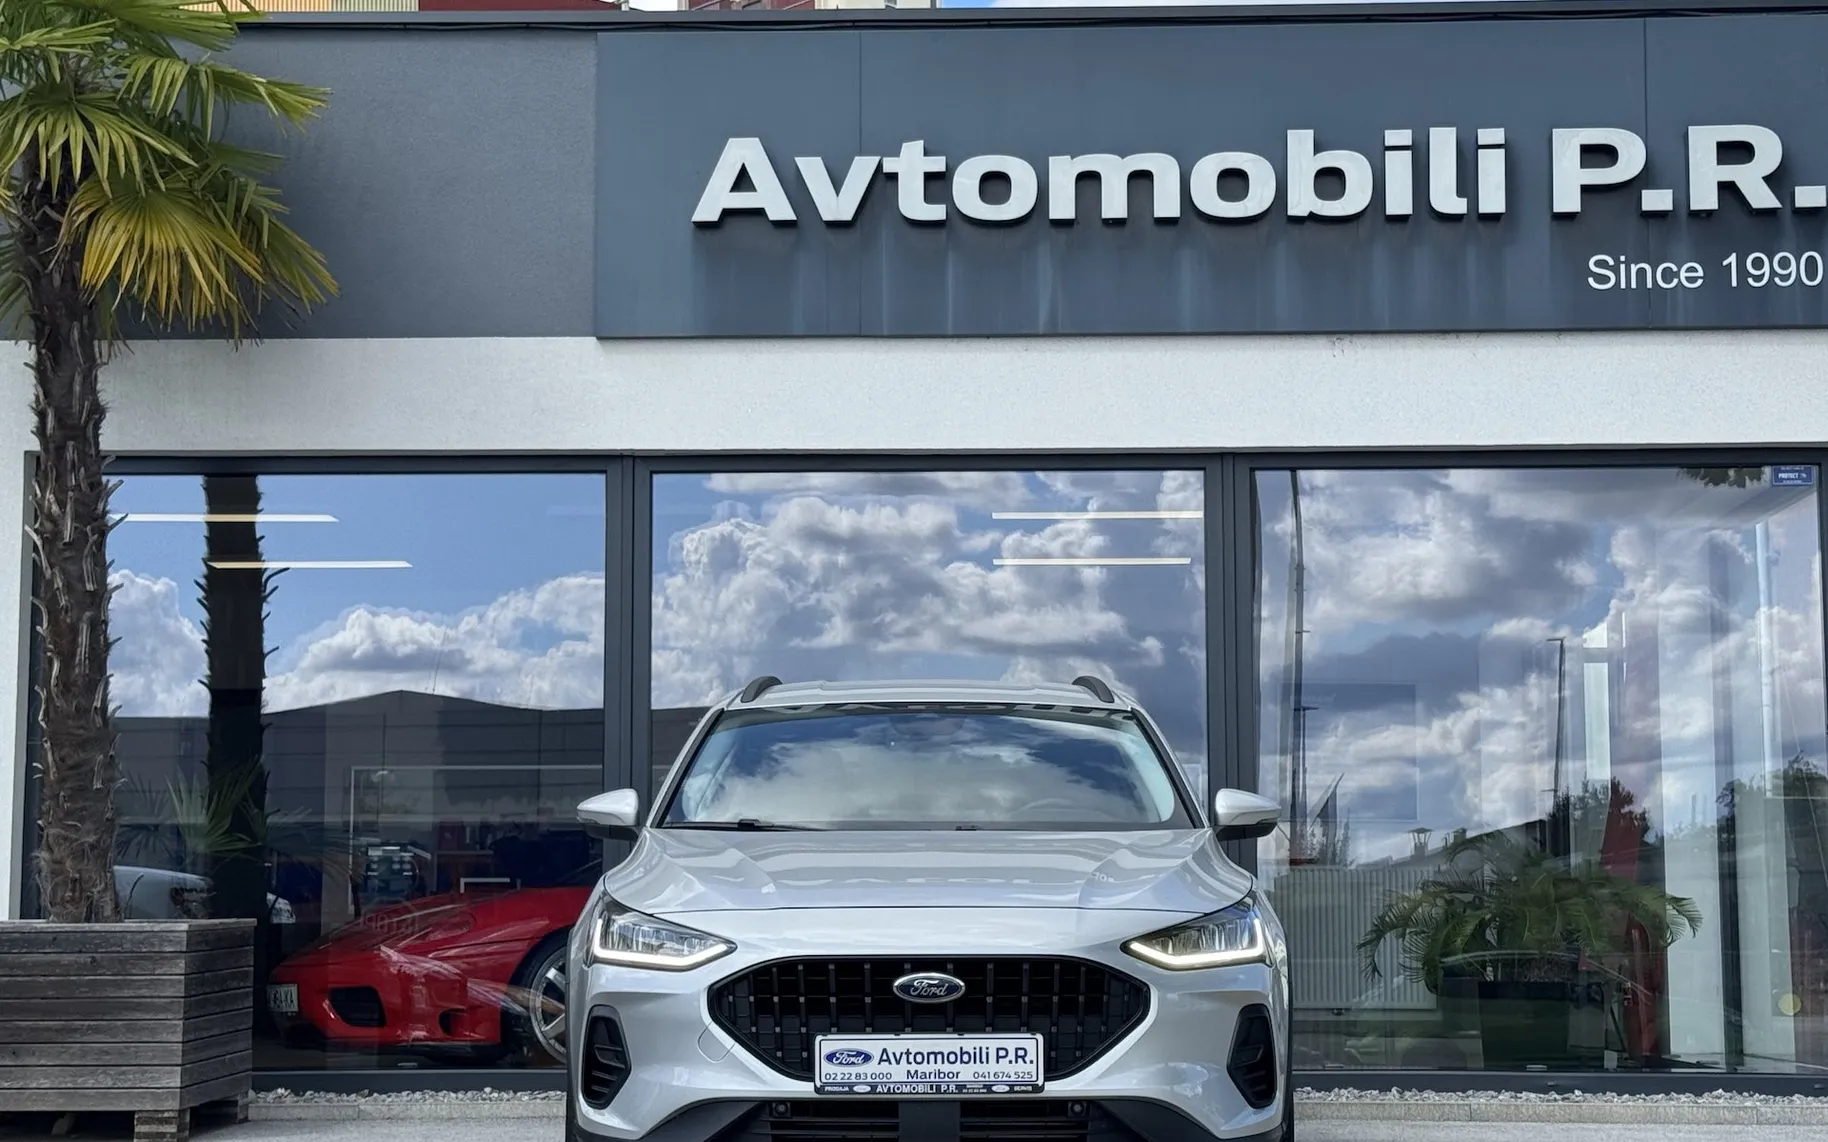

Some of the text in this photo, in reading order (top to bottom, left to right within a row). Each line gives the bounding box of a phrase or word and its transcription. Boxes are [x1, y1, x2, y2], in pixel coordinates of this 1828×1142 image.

[691, 124, 1827, 223] Avtomobili P.R.
[1587, 251, 1824, 290] Since 1990
[910, 979, 949, 996] Ford
[832, 1051, 866, 1064] Ford
[877, 1046, 1034, 1066] Avtomobili P.R.
[870, 1072, 892, 1081] 000
[906, 1068, 961, 1080] Maribor
[973, 1071, 1033, 1080] 041 674 525
[876, 1083, 936, 1093] AVTOMOBILI
[941, 1083, 959, 1093] P.R.
